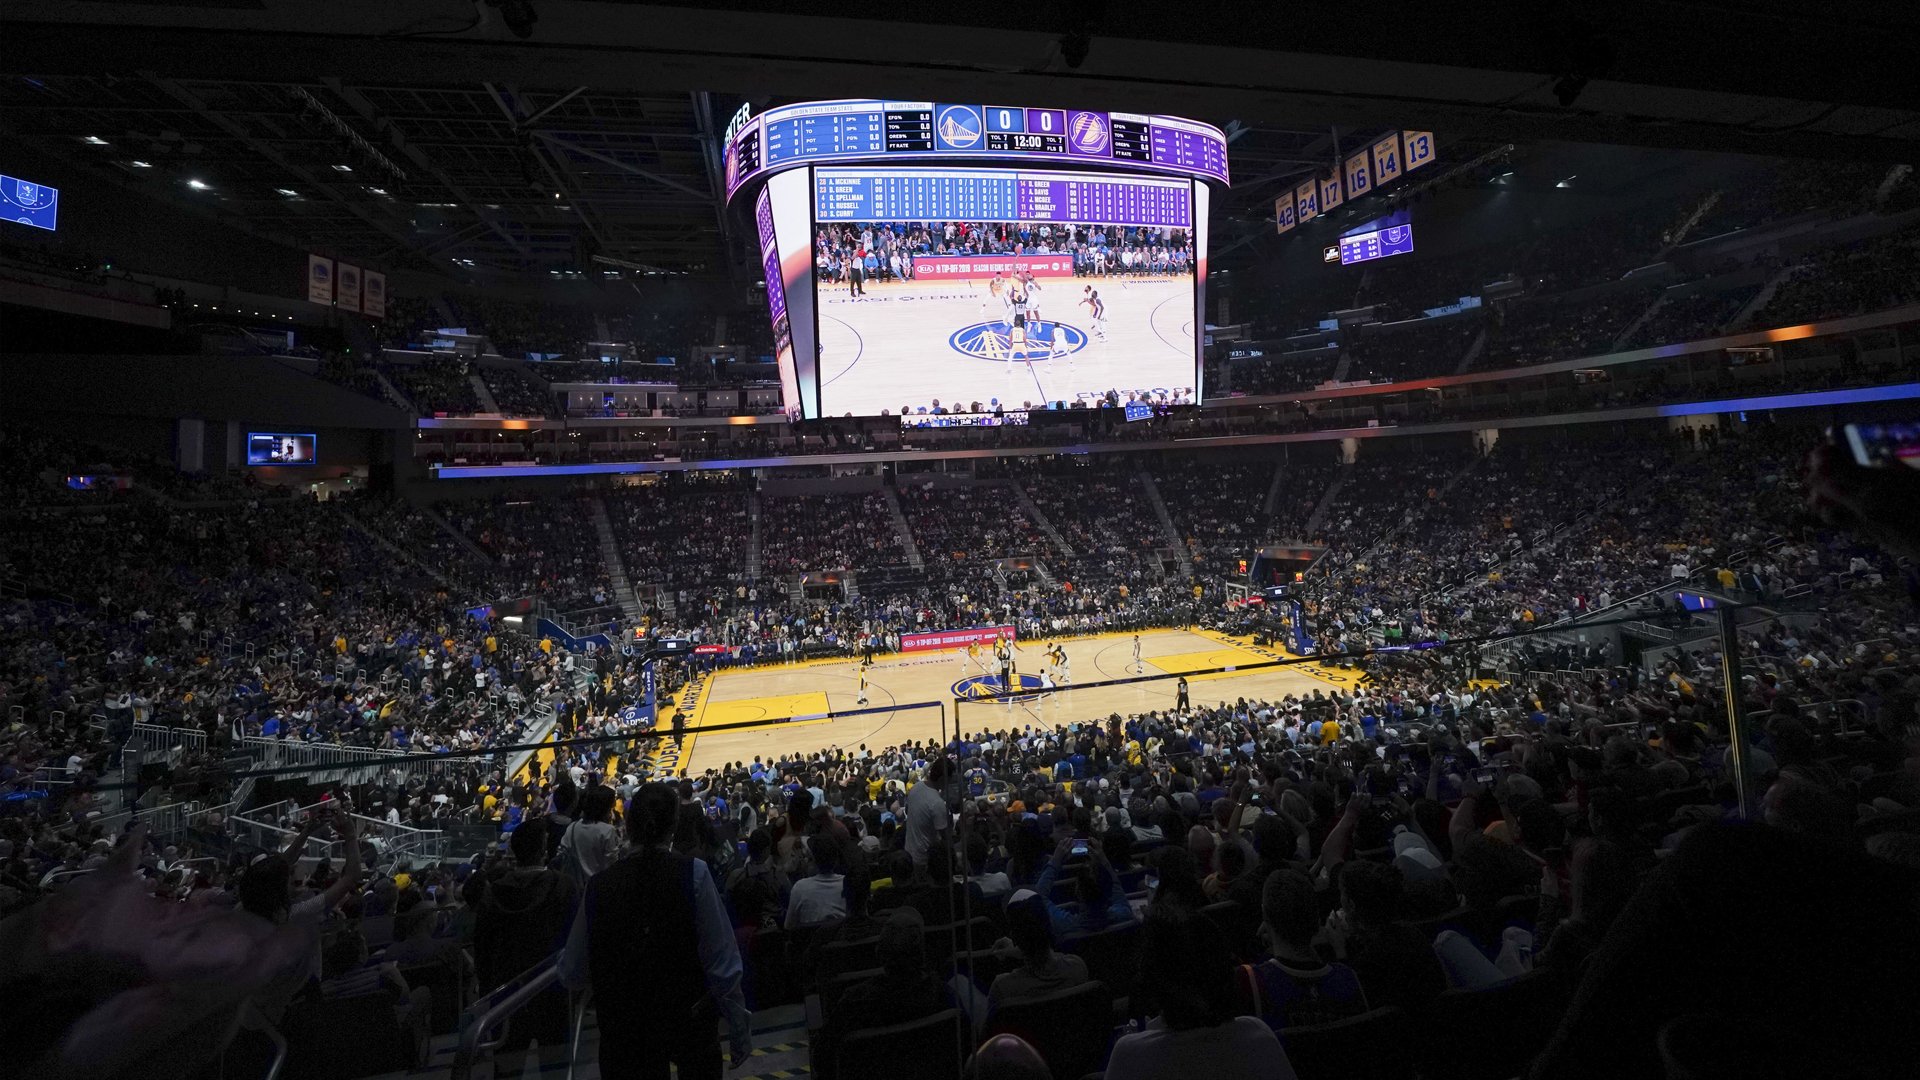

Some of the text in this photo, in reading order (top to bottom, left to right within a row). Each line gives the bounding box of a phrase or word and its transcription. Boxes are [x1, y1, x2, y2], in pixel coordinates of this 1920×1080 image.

[1000, 110, 1010, 129] 0
[1041, 112, 1052, 131] 0
[1014, 136, 1041, 147] 12:00
[1410, 136, 1429, 163] 13
[1379, 152, 1396, 178] 14
[1350, 168, 1367, 193] 16
[1324, 182, 1338, 205] 17
[1279, 206, 1293, 227] 42
[1300, 194, 1315, 218] 24
[918, 264, 933, 273] KIA
[1216, 637, 1244, 646] SAN
